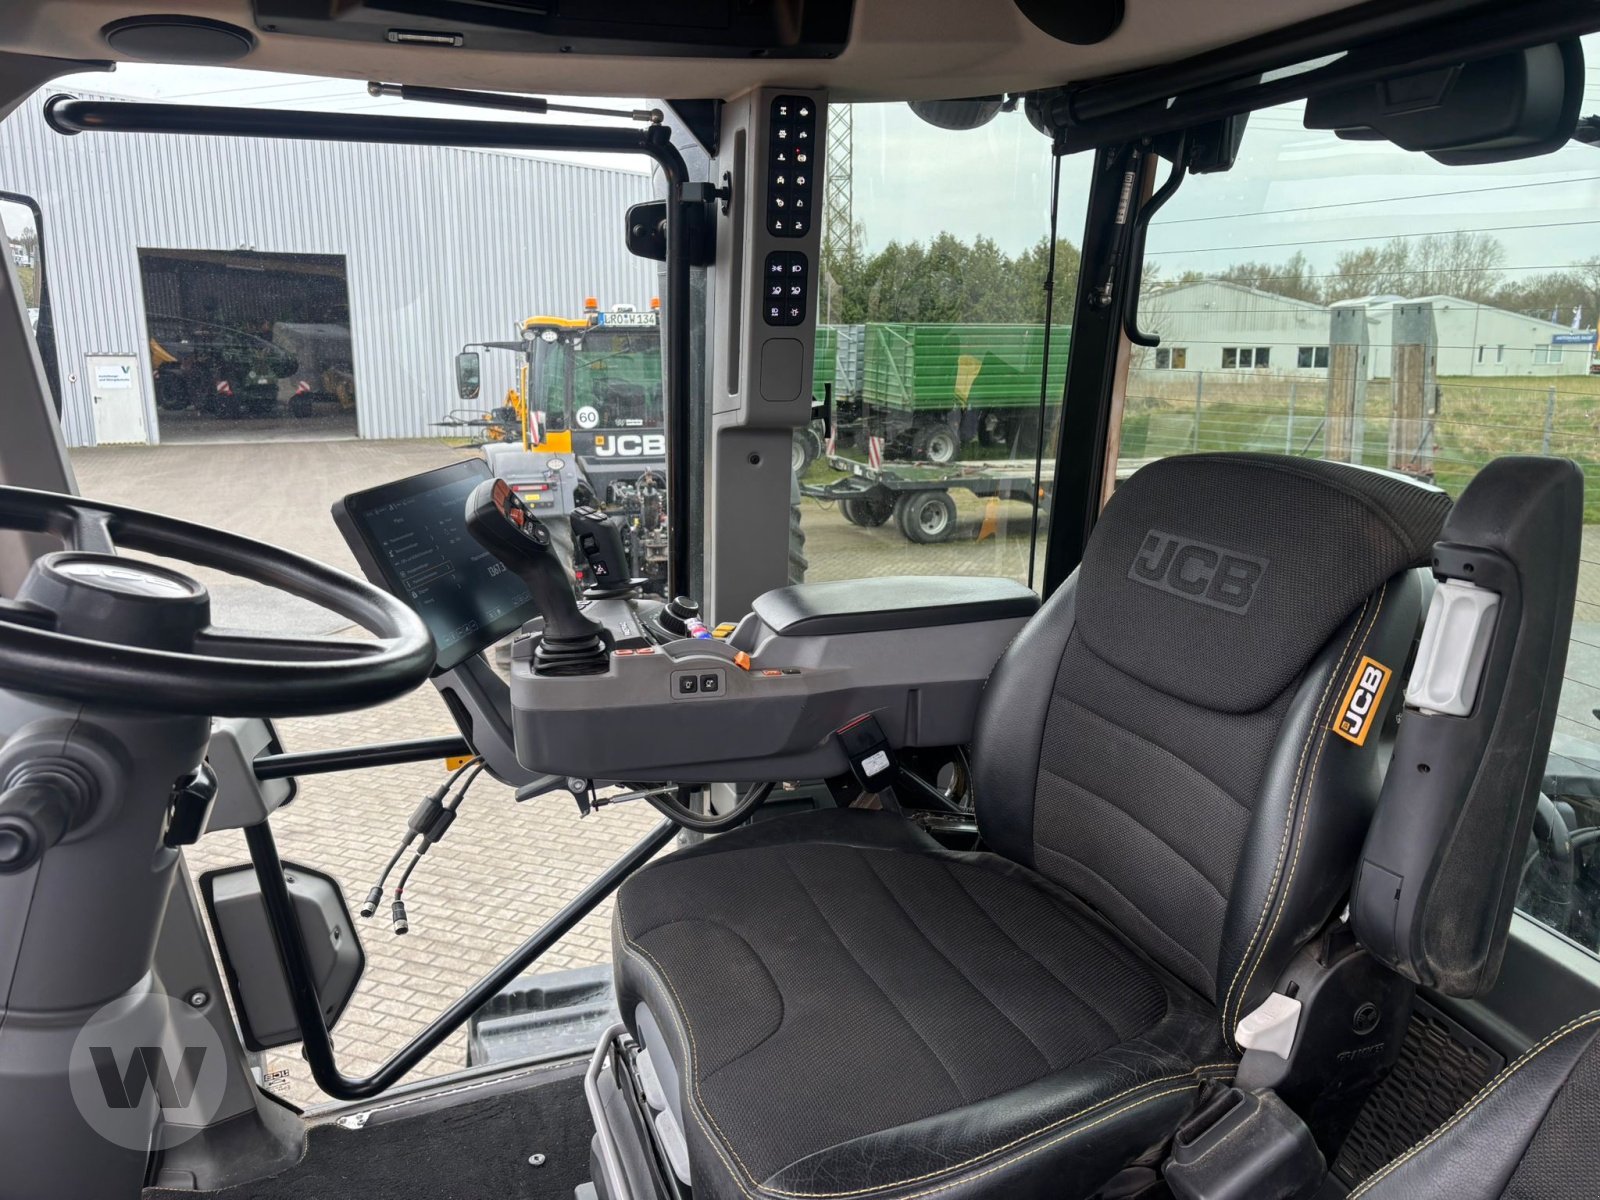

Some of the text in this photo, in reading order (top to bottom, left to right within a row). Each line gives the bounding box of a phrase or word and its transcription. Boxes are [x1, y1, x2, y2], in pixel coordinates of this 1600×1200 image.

[579, 412, 596, 423] 60
[595, 435, 666, 457] JCB
[1132, 532, 1266, 610] JCB
[1347, 665, 1384, 735] JCB
